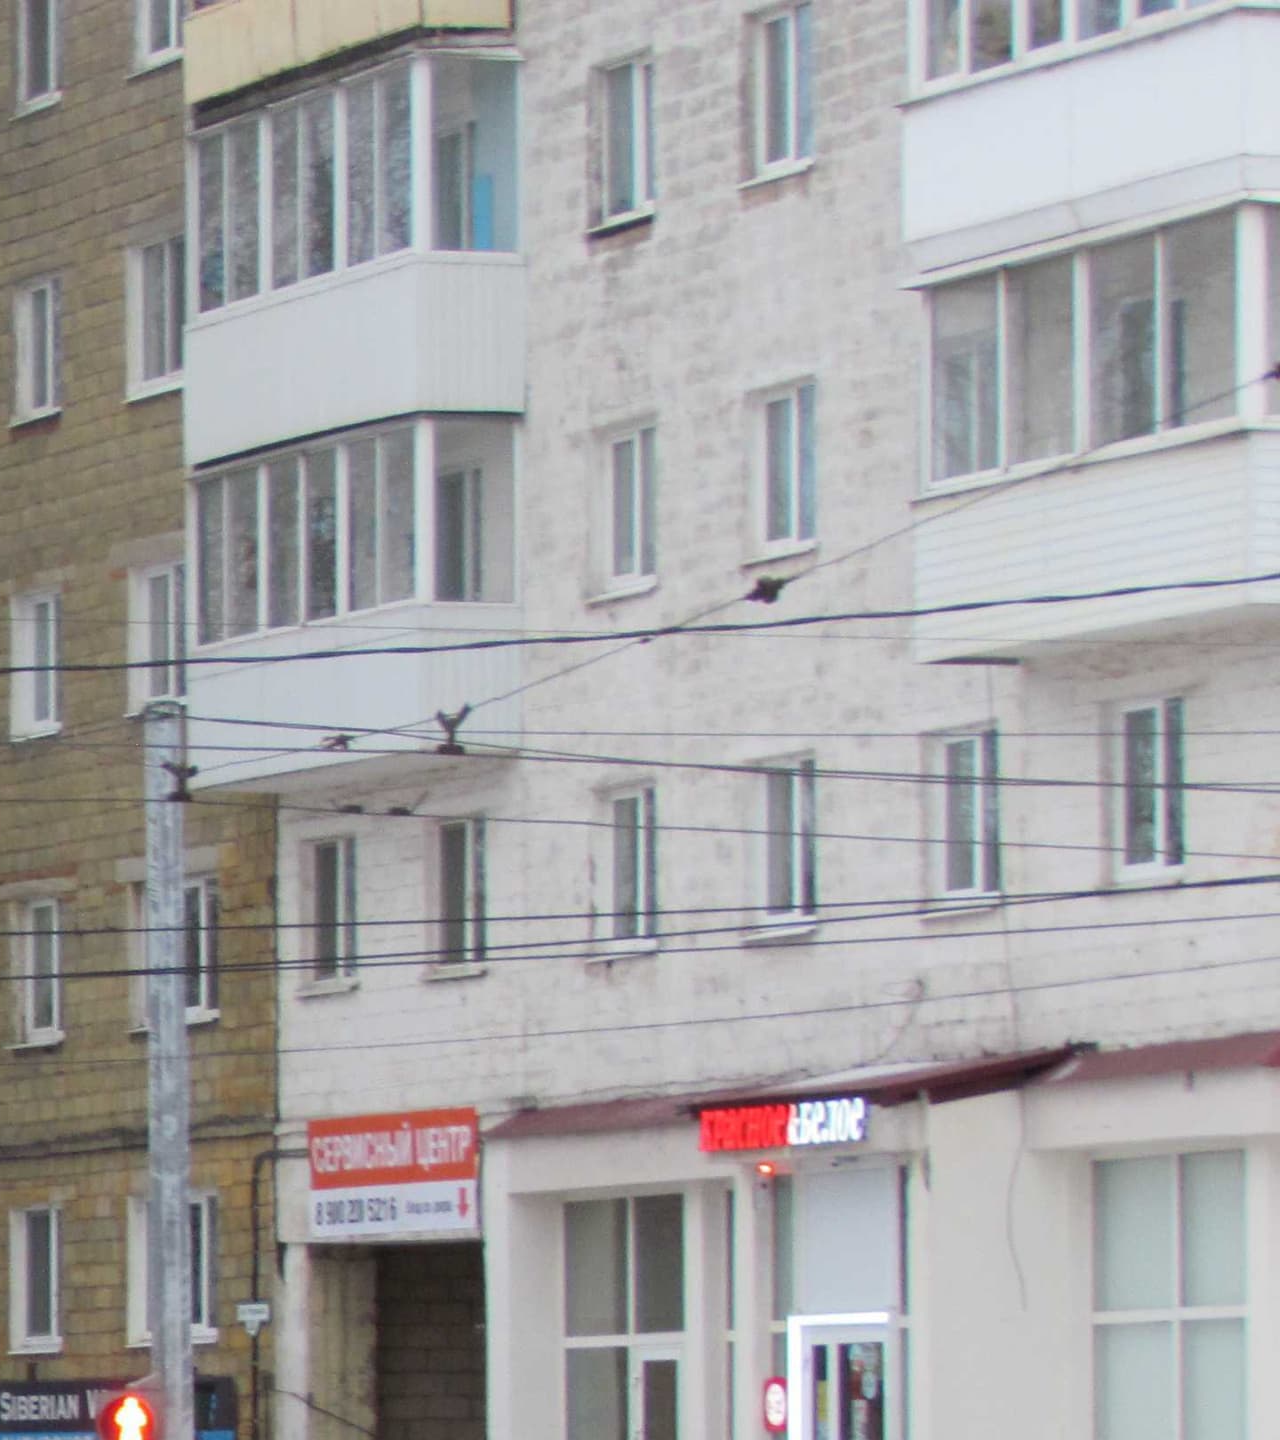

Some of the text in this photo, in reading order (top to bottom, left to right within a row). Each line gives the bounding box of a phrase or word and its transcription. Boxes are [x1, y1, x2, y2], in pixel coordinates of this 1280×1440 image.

[311, 1121, 472, 1174] СЕРВИСНЫЙ ЦЕНТР
[0, 1391, 81, 1421] SIBERIAN
